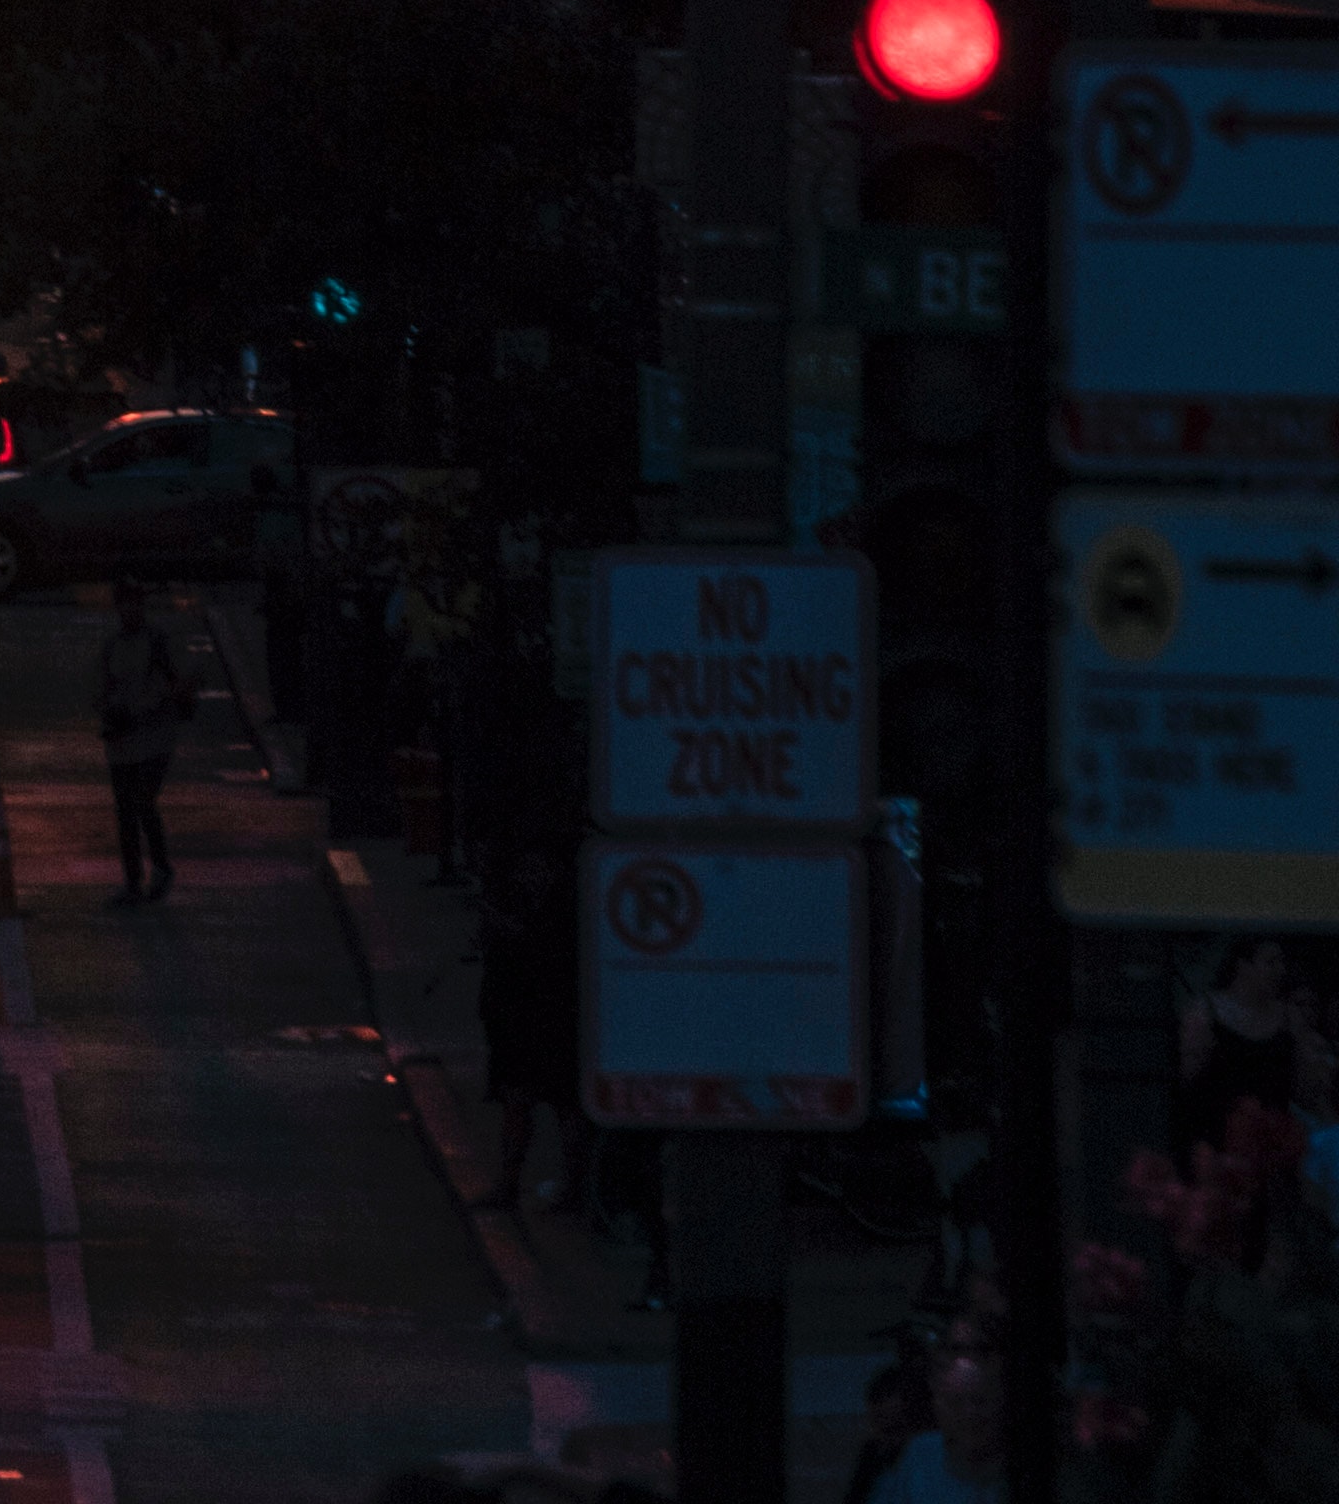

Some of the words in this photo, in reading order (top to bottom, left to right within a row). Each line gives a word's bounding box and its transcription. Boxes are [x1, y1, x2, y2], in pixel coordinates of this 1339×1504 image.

[919, 248, 998, 317] BE
[698, 575, 769, 642] NO
[615, 651, 853, 722] CRUISING
[669, 731, 802, 800] ZONE
